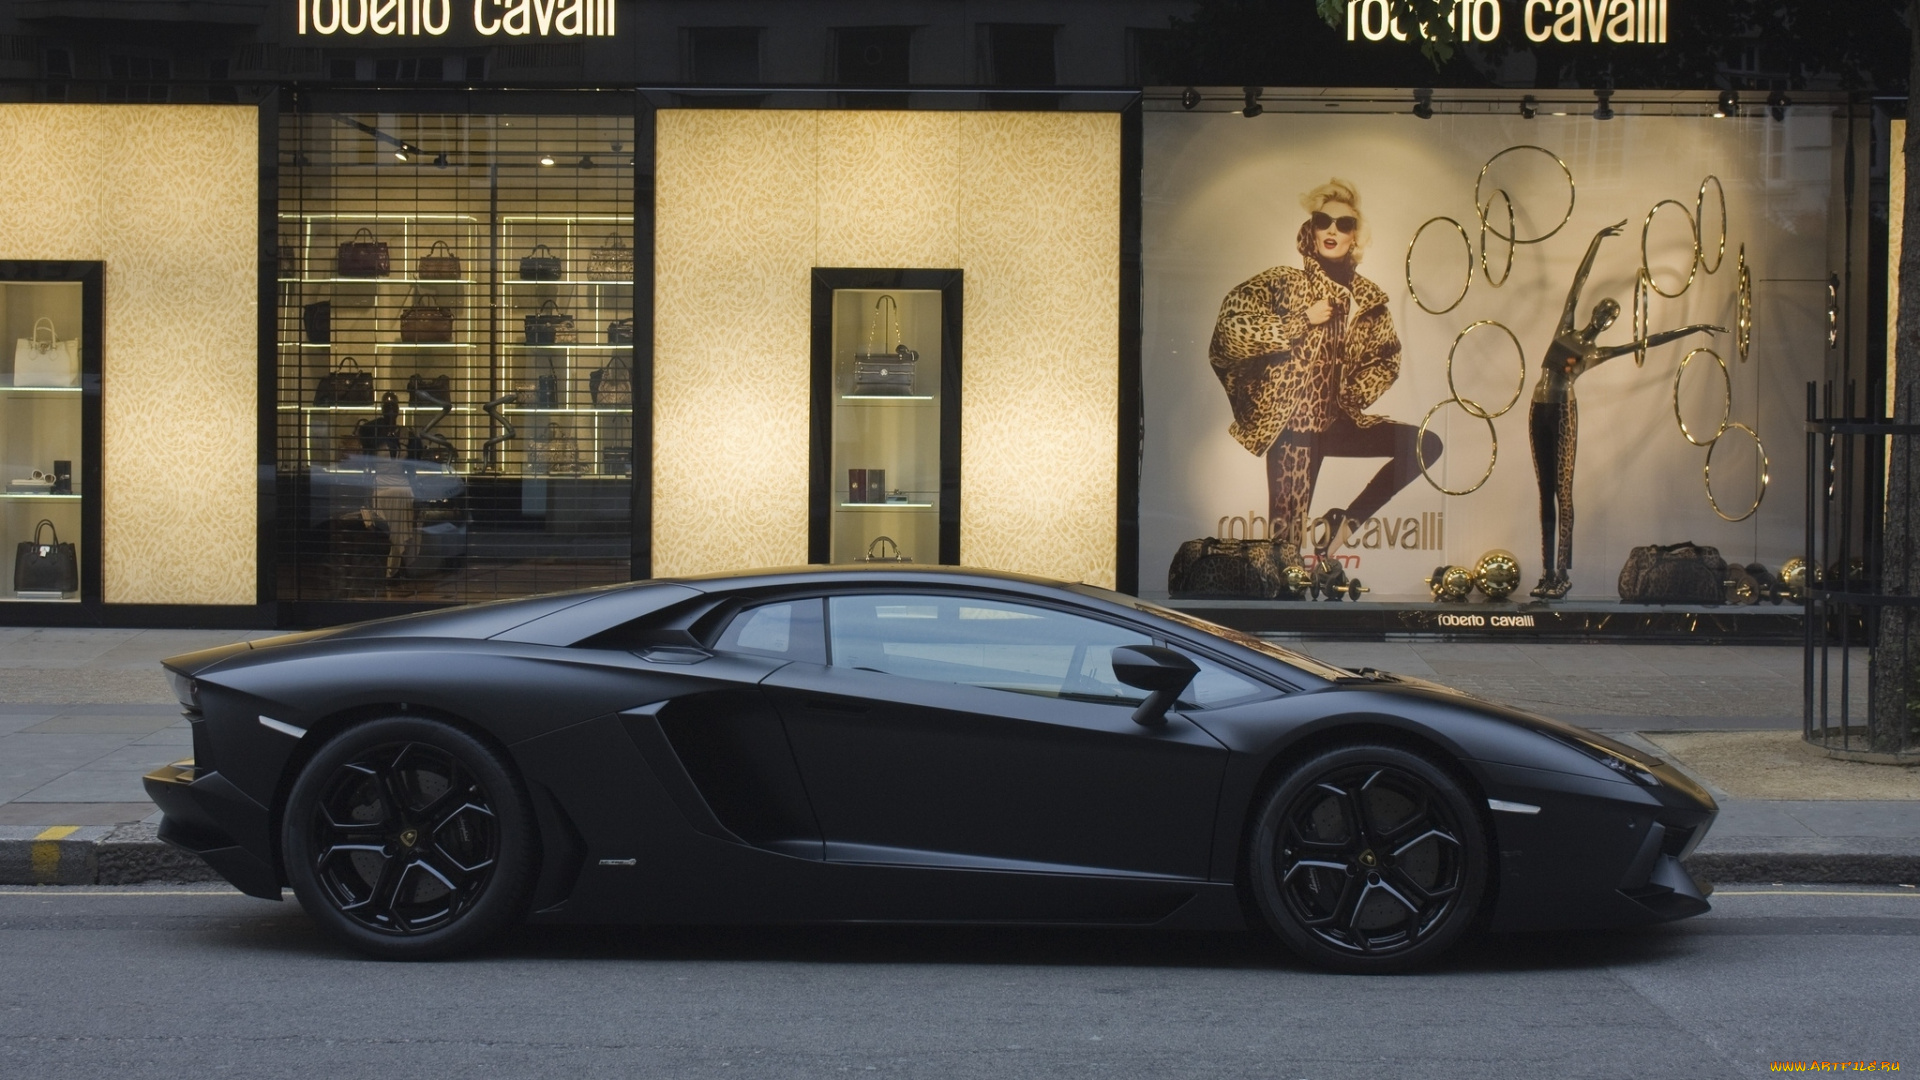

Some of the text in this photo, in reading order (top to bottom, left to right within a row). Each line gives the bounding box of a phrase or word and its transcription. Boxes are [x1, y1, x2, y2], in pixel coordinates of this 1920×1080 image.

[1524, 0, 1668, 43] cavalli
[1342, 511, 1443, 551] cavalli
[1438, 614, 1535, 627] roberto cavalli
